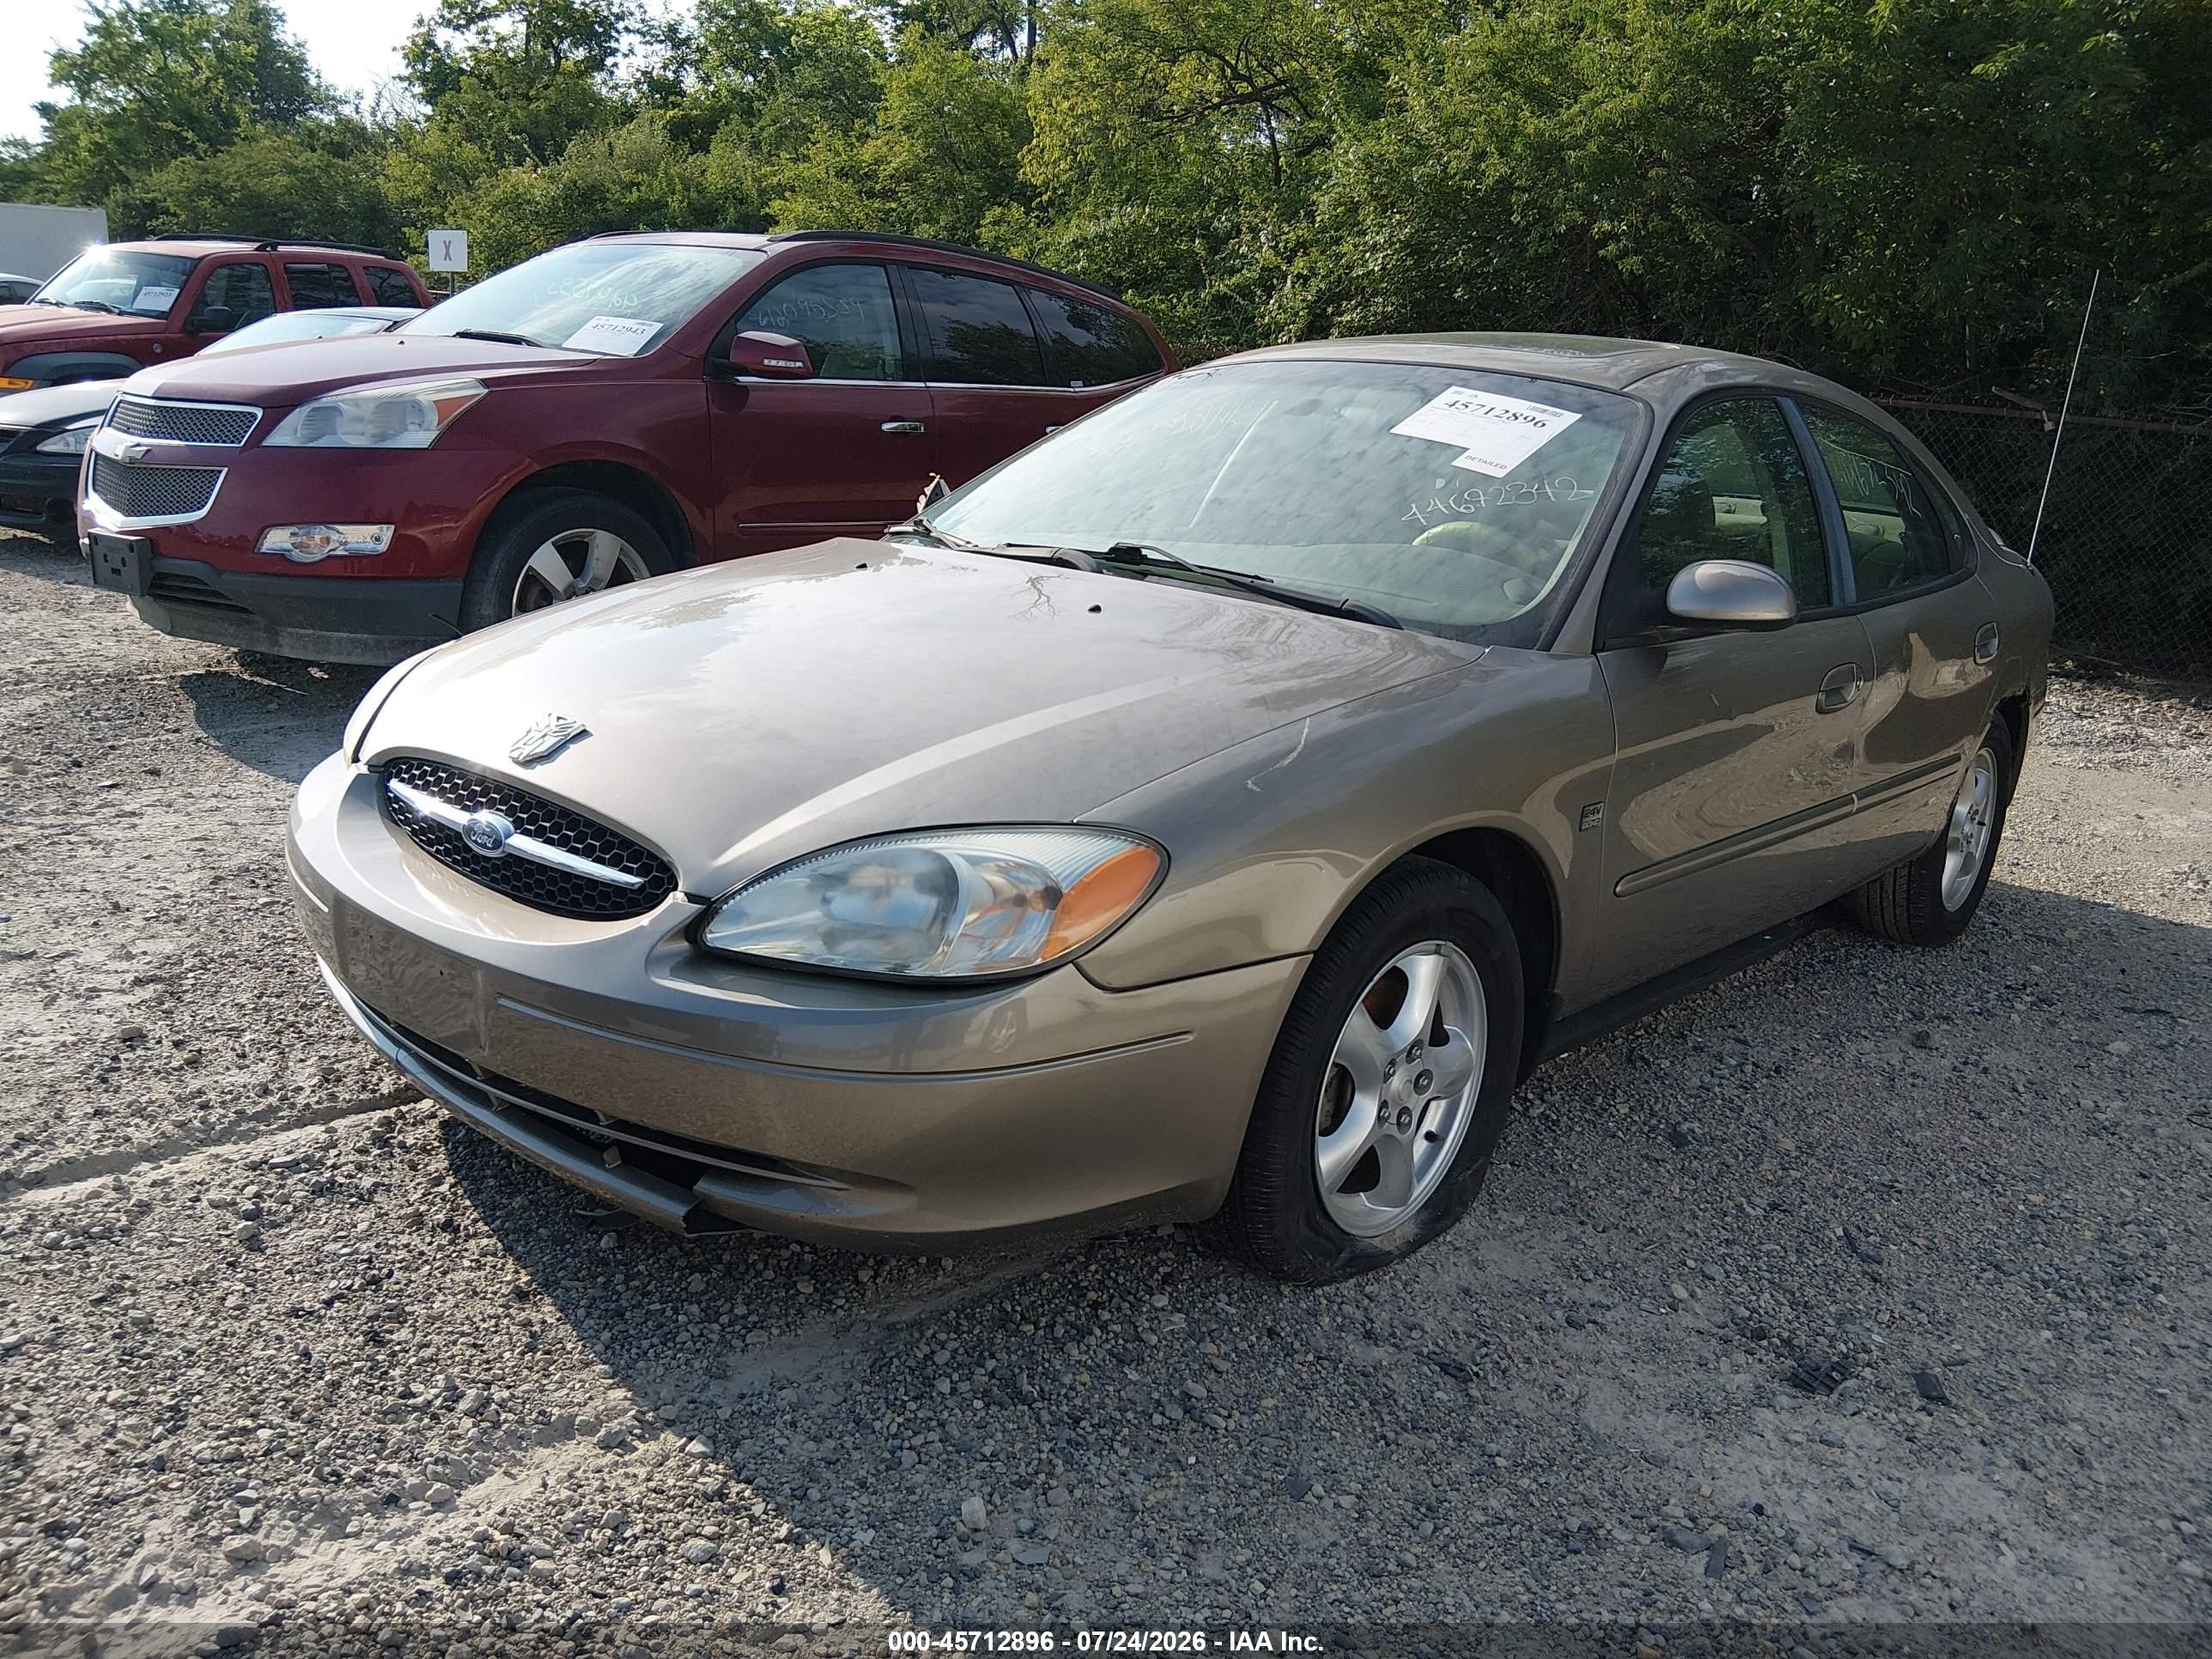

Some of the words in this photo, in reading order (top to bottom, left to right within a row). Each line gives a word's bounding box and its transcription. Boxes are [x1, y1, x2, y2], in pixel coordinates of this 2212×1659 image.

[443, 240, 452, 261] X
[1444, 400, 1552, 428] 45712896
[1464, 455, 1508, 470] DETAILED
[471, 823, 496, 848] Ford
